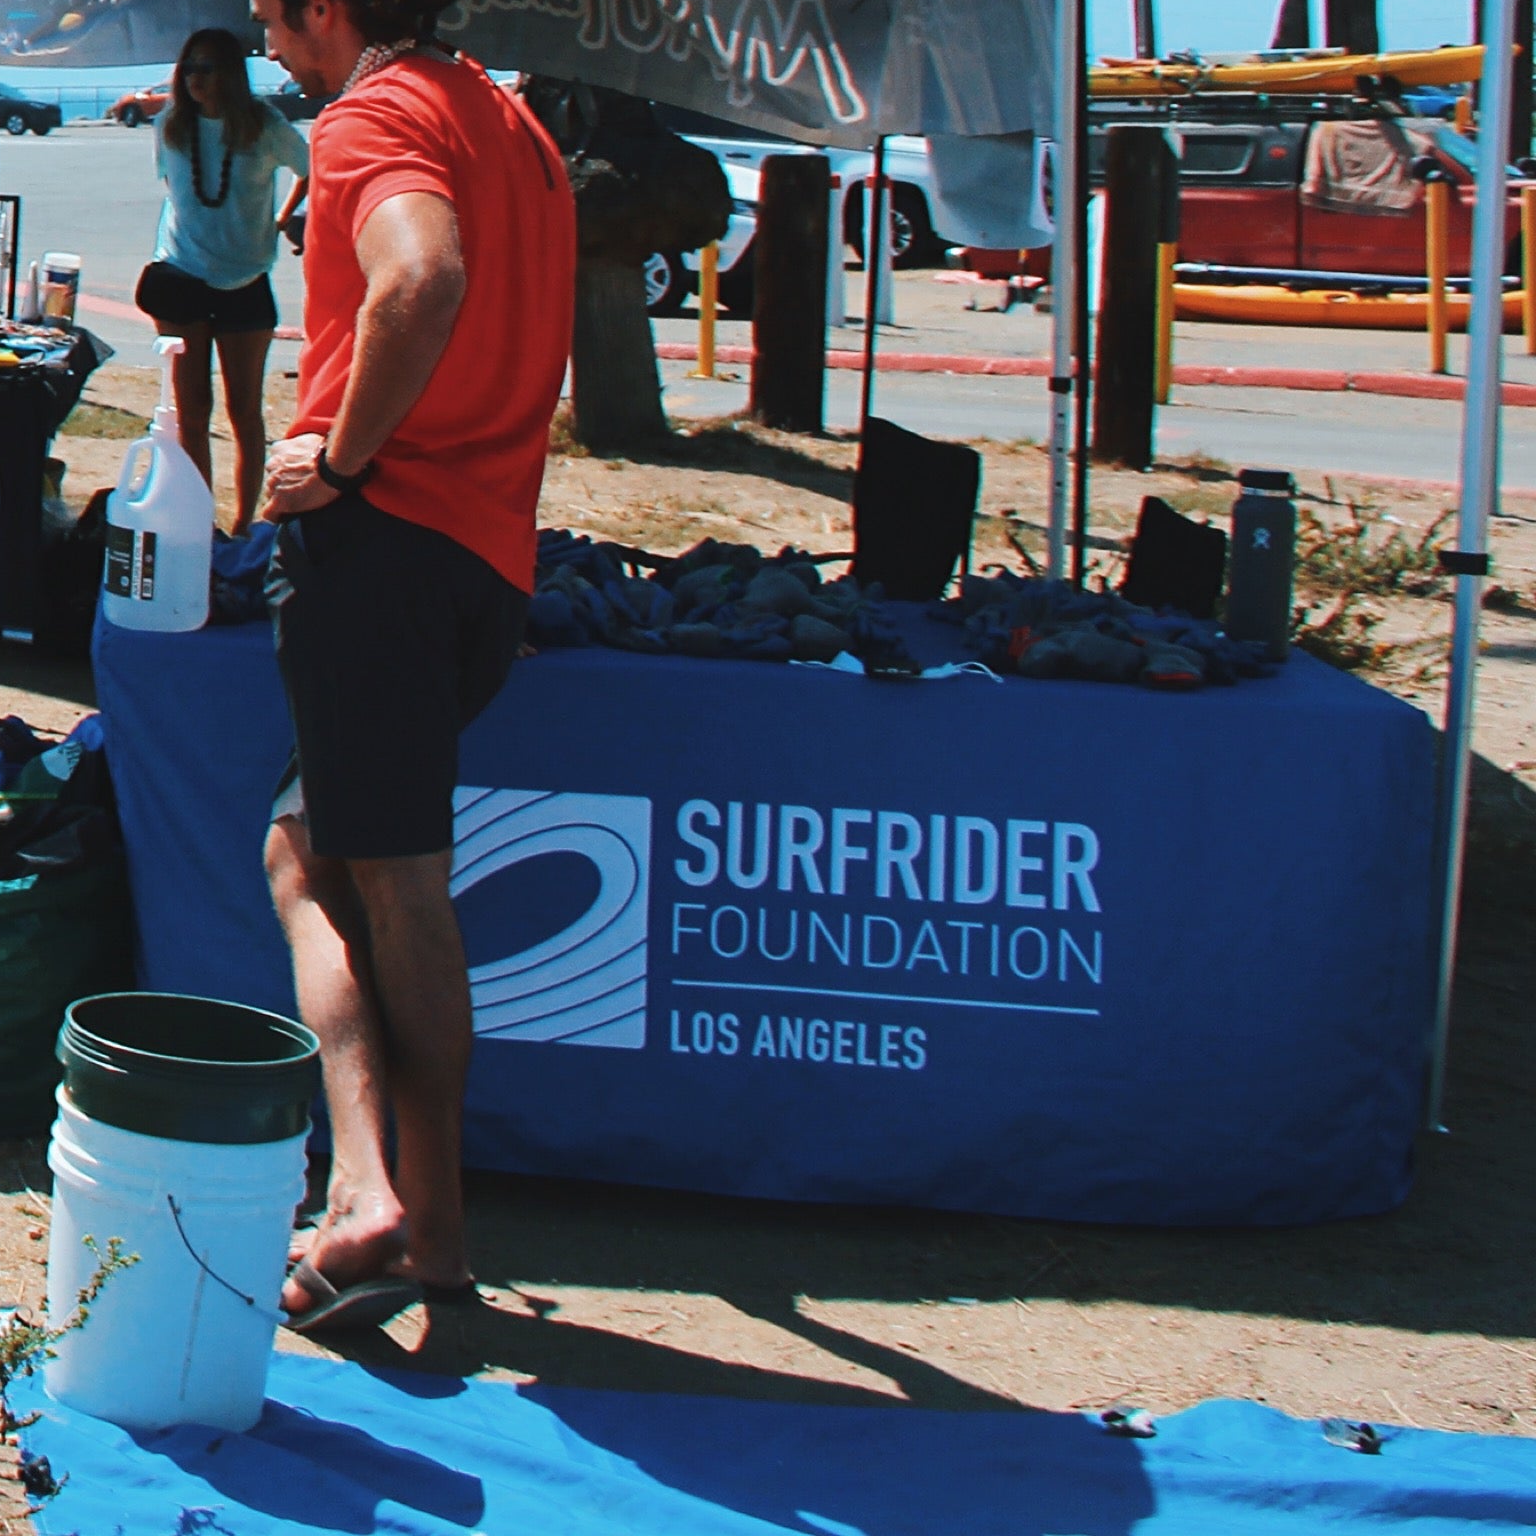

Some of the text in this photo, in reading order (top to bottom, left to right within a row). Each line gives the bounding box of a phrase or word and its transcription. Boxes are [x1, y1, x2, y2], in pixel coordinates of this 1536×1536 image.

[674, 799, 1102, 913] SURFRIDER
[670, 903, 1103, 985] FOUNDATION
[670, 1010, 927, 1071] LOS ANGELES
